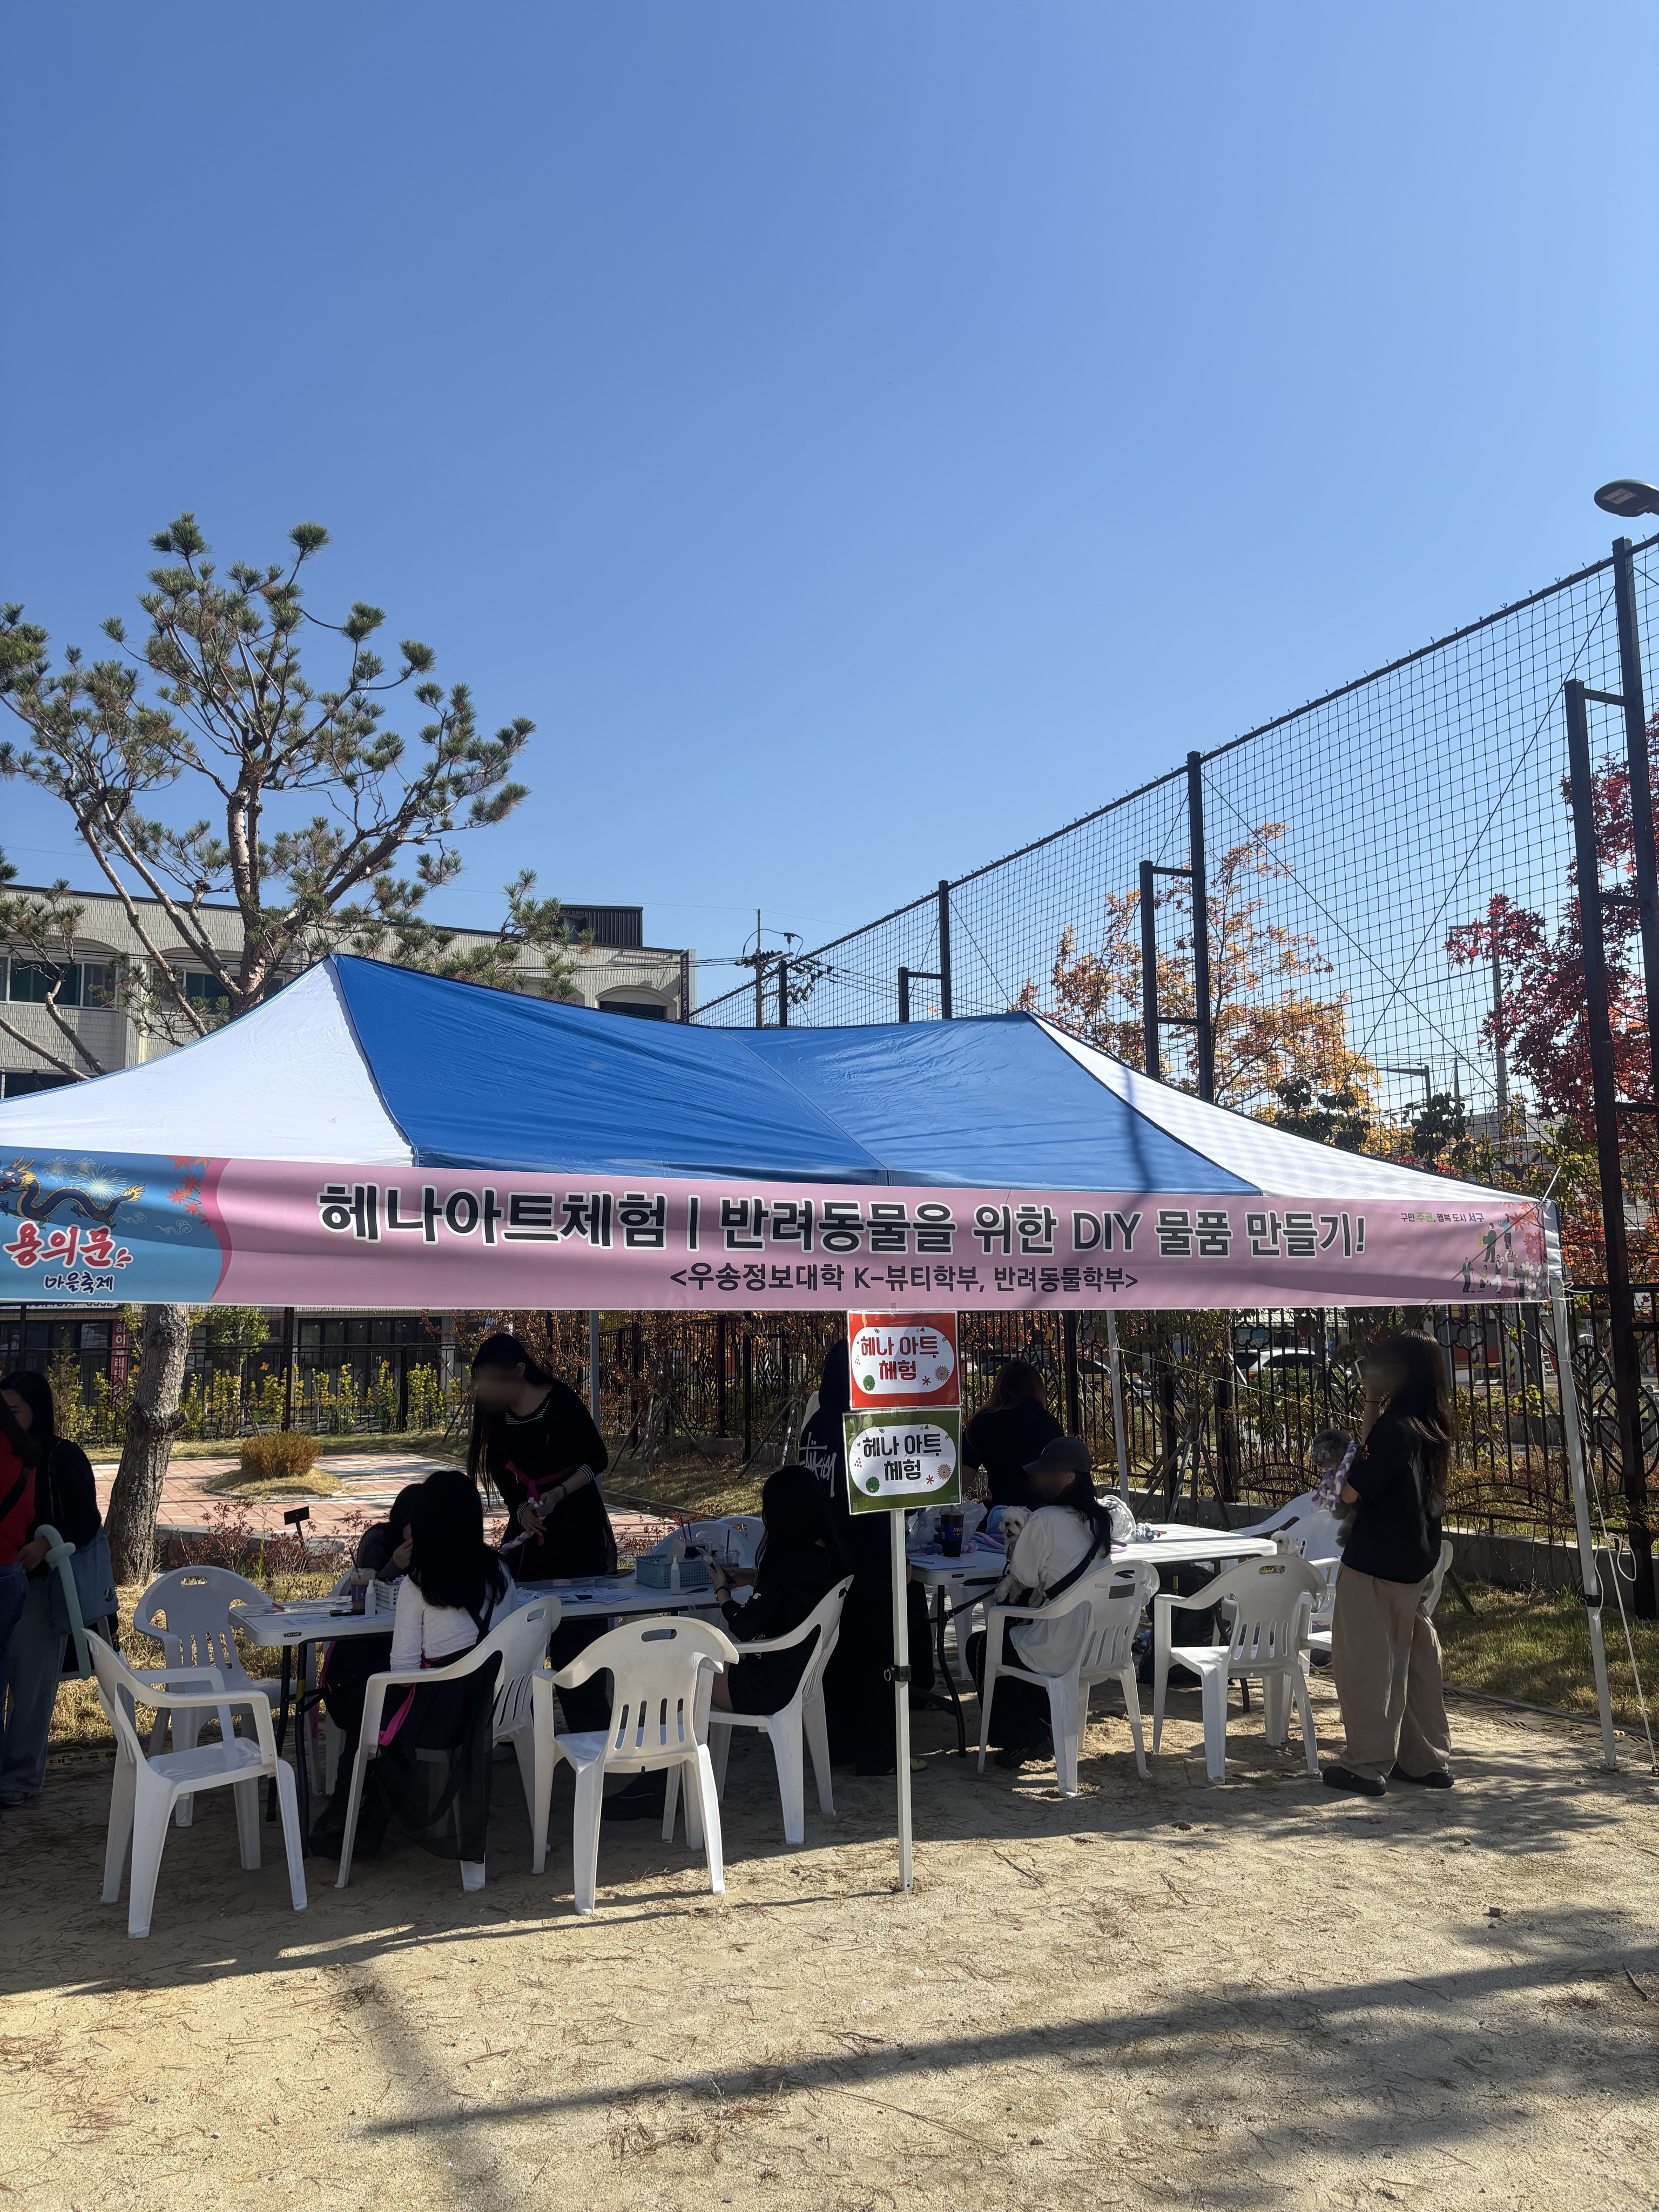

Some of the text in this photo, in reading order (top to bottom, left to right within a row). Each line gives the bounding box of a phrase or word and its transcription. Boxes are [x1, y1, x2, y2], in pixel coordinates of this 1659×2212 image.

[318, 1184, 666, 1250] 헤나아트체험
[720, 1197, 956, 1254] 반려동물을
[973, 1205, 1057, 1255] 위한
[1073, 1211, 1142, 1251] DIY
[1156, 1209, 1231, 1258] 물품
[1246, 1212, 1365, 1258] 만들기!
[1400, 1213, 1415, 1222] 구민
[1437, 1213, 1451, 1222] 행복
[1453, 1213, 1467, 1222] 도시
[1468, 1213, 1484, 1223] 서구
[5, 1222, 115, 1267] 용의문
[44, 1270, 114, 1294] 마을축제
[670, 1262, 1138, 1293] <우송정보대학 K-뷰티학부, 반려동물학부>
[860, 1336, 939, 1356] 헤나 아트
[879, 1360, 917, 1381] 체험
[862, 1433, 942, 1458] 헤나 아트
[884, 1459, 921, 1481] 체험
